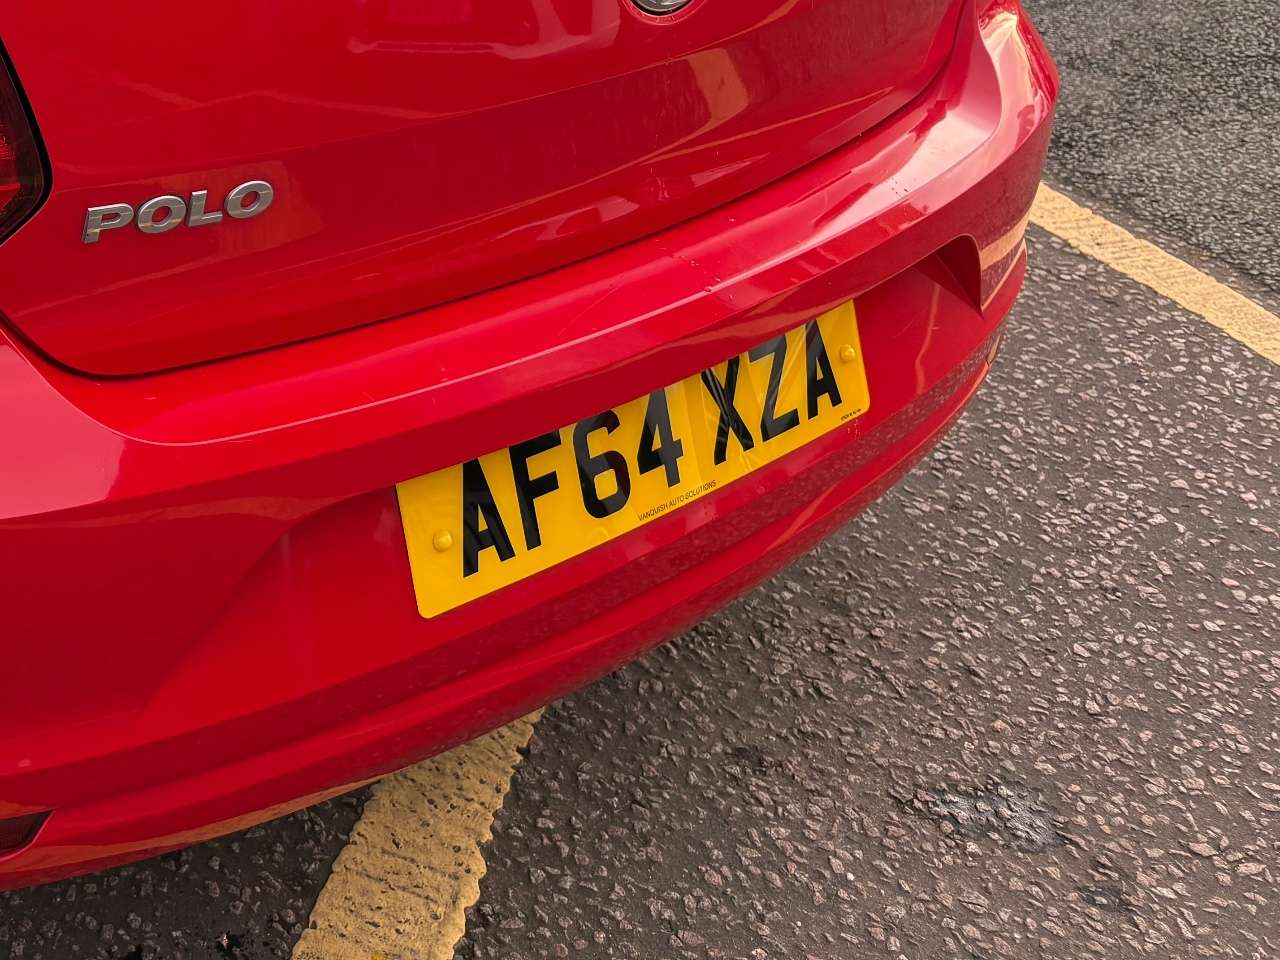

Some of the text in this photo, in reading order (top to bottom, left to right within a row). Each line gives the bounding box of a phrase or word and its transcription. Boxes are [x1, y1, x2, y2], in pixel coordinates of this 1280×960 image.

[82, 180, 274, 244] POLO
[462, 319, 843, 578] AF64 XZA
[638, 480, 717, 521] VANQUISH AUTO SOLUTIONS
